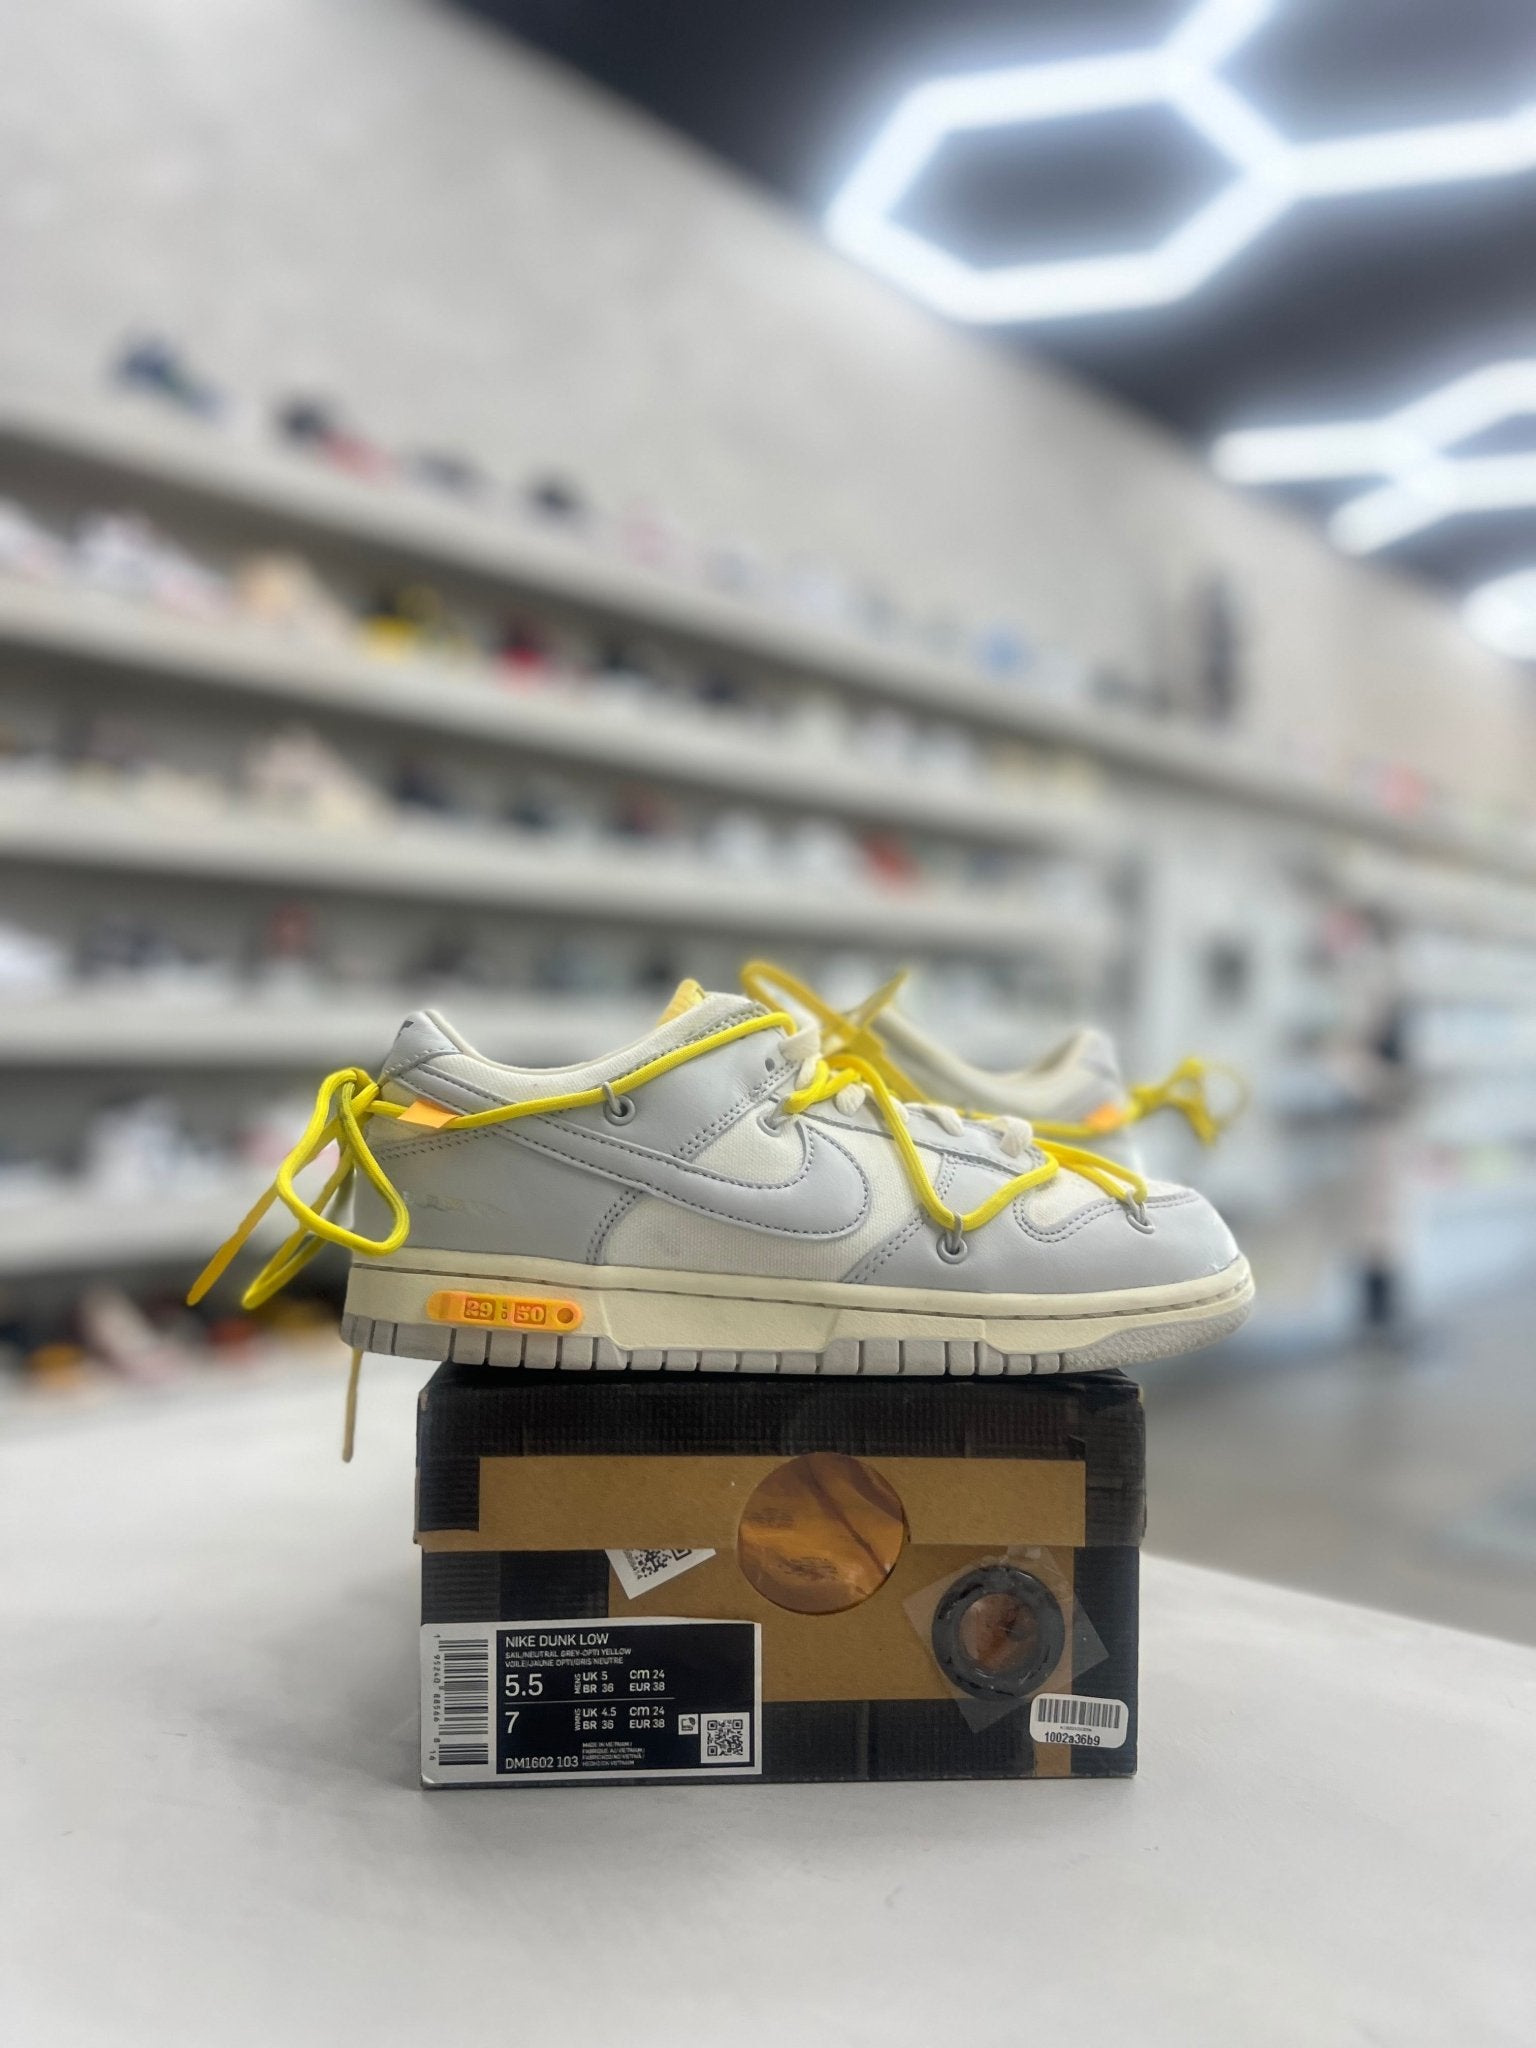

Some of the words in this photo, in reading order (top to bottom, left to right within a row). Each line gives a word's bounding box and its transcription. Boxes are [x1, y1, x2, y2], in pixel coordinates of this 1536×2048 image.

[466, 1300, 492, 1318] 29
[516, 1306, 544, 1322] 50
[506, 1635, 536, 1648] NIKE
[540, 1634, 576, 1646] DUNK
[580, 1632, 608, 1645] LOW
[601, 1648, 632, 1656] YELLOW
[593, 1656, 624, 1665] NEUTRE
[582, 1672, 598, 1681] UK
[602, 1671, 608, 1680] 5
[653, 1670, 665, 1679] 24
[505, 1673, 543, 1696] 5.5
[582, 1684, 597, 1693] BR
[602, 1683, 614, 1692] 36
[630, 1682, 650, 1691] EUR
[653, 1682, 665, 1691] 38
[582, 1708, 598, 1717] UK
[602, 1707, 616, 1716] 4.5
[653, 1706, 665, 1715] 24
[505, 1712, 519, 1734] 7
[582, 1720, 597, 1729] BR
[602, 1720, 614, 1729] 36
[630, 1719, 650, 1728] EUR
[653, 1719, 665, 1728] 38
[1044, 1731, 1100, 1746] 1002a36b9
[505, 1757, 554, 1769] DM1602
[557, 1756, 579, 1767] 103
